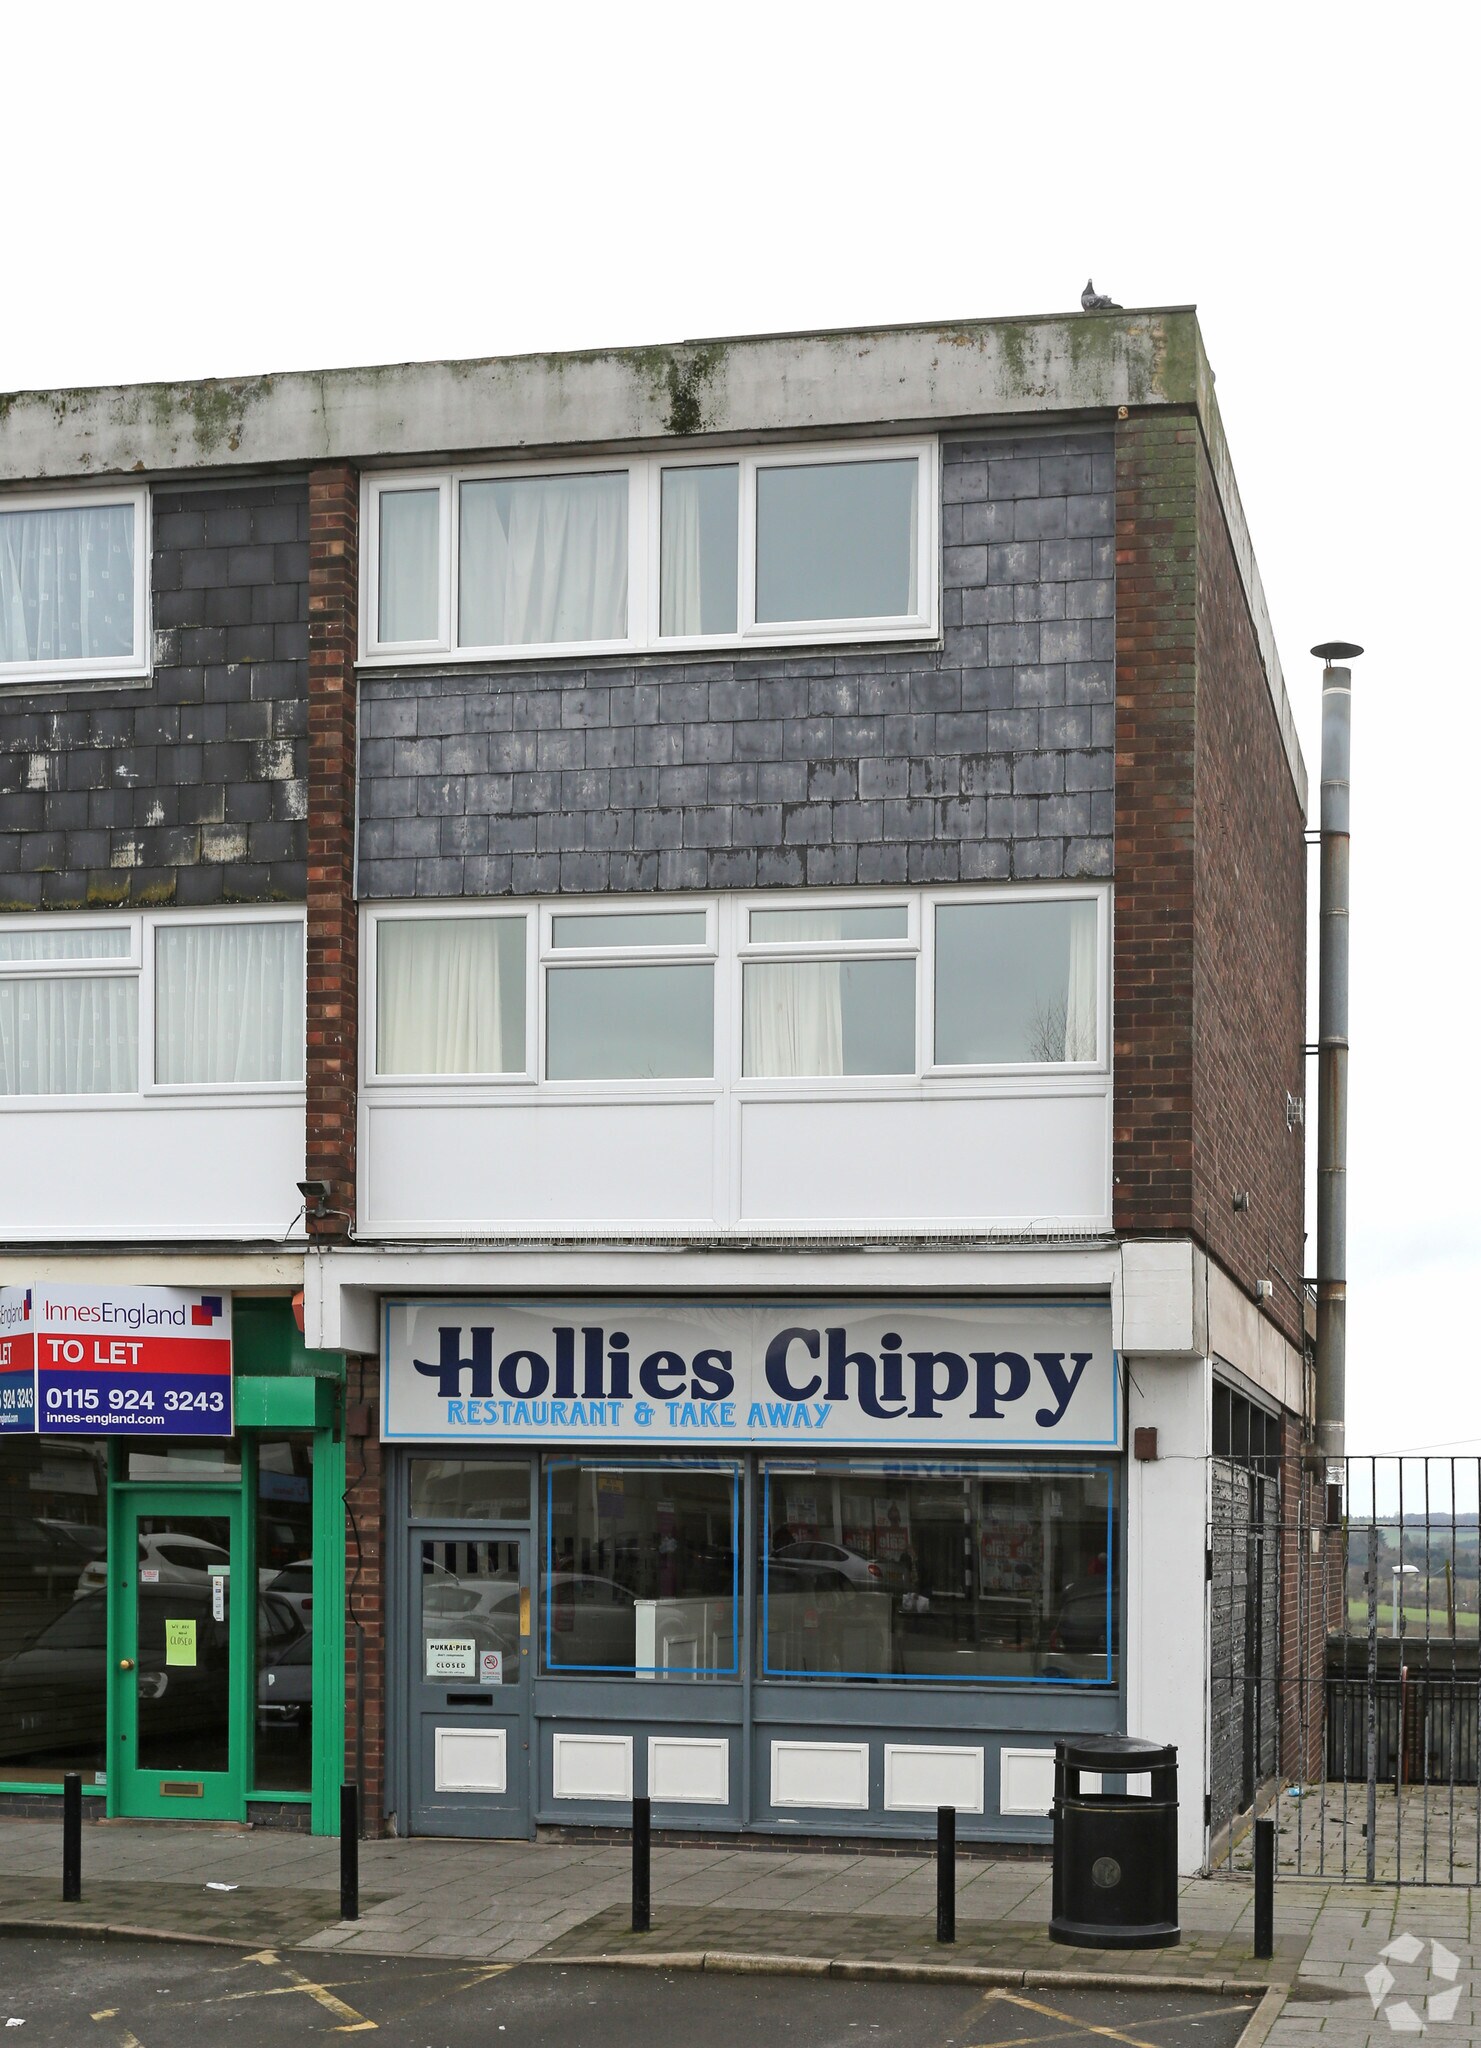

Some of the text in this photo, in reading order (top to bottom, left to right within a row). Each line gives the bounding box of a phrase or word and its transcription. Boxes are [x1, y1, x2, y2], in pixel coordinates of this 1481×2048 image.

[45, 1300, 186, 1330] InnesEngland
[46, 1339, 144, 1366] TO LET
[413, 1326, 1093, 1428] Hollies Chippy
[2, 1389, 17, 1410] 924
[17, 1387, 35, 1409] 3243
[46, 1388, 224, 1412] 0115 924 3243
[46, 1411, 165, 1426] innes-england.com
[447, 1400, 833, 1429] RESTAURANT & TAKE AWAY
[170, 1636, 193, 1646] CLOSED
